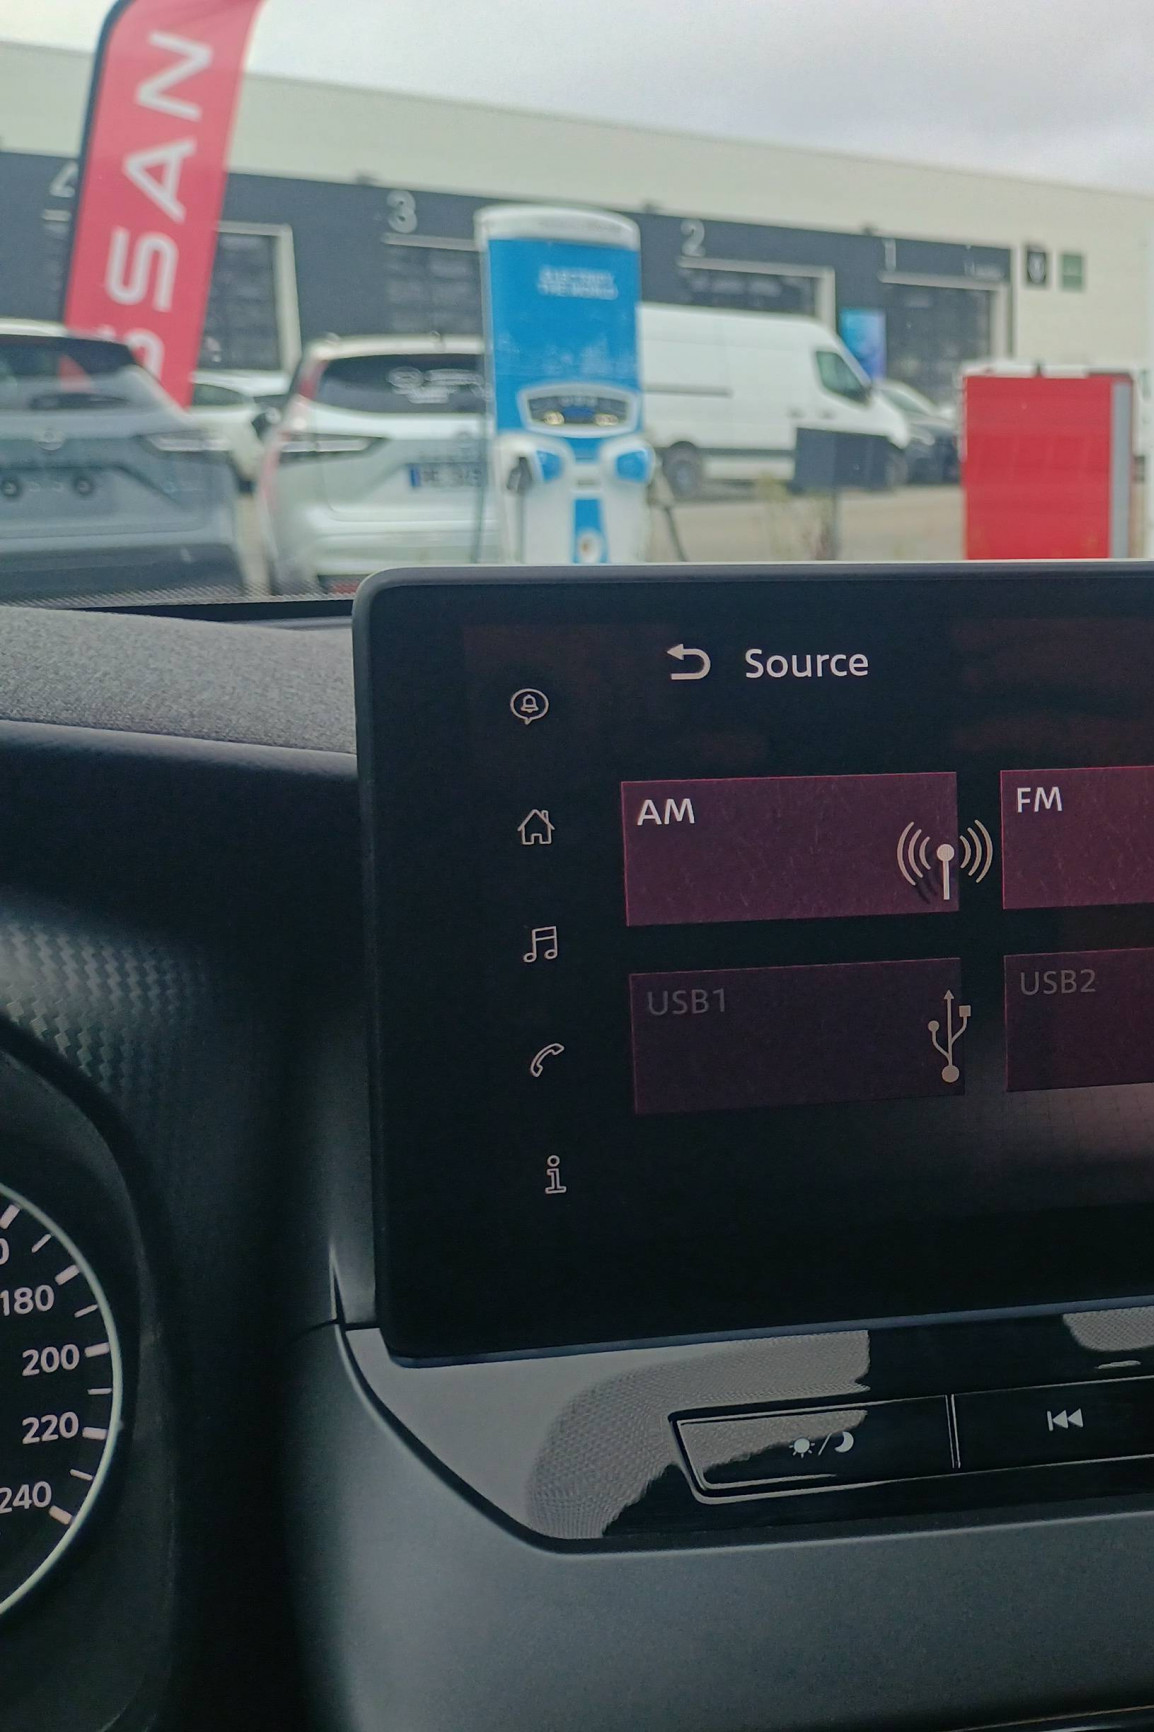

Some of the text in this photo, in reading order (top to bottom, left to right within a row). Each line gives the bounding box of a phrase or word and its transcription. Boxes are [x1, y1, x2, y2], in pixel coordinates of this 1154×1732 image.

[387, 189, 418, 234] 3
[680, 218, 706, 257] 2
[745, 648, 869, 679] Source
[636, 797, 695, 826] AM
[1016, 786, 1063, 813] FM
[1020, 968, 1096, 996] USB2
[647, 987, 726, 1016] USB1
[0, 1284, 55, 1316] 180
[22, 1343, 80, 1377] 200
[22, 1411, 79, 1444] 220
[0, 1480, 52, 1514] 240
